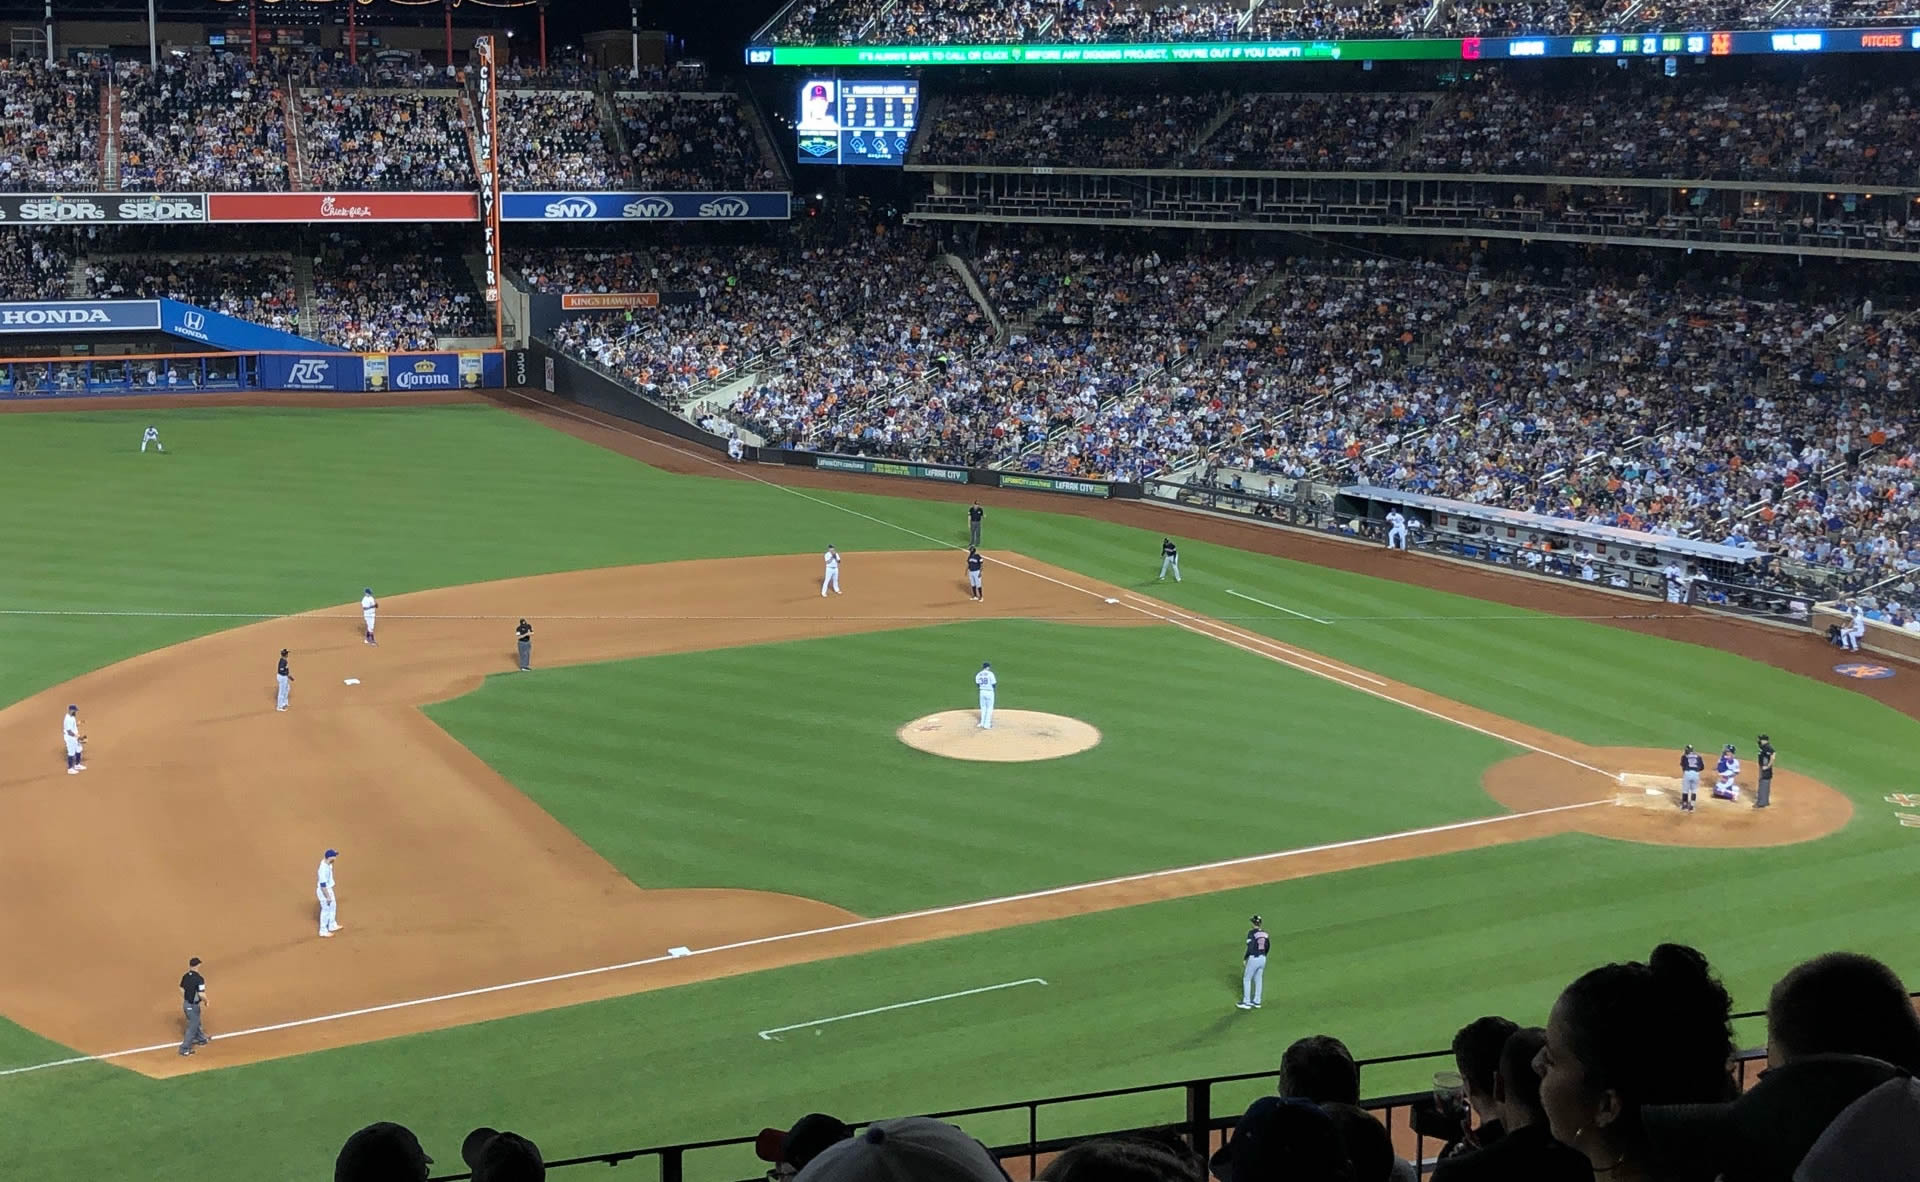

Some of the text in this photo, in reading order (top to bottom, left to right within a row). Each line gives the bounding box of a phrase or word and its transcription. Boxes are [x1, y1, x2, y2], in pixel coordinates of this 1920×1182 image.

[1572, 40, 1592, 53] AVG
[1643, 38, 1656, 53] 21
[1861, 34, 1903, 47] PITCHES
[932, 51, 944, 60] TO
[945, 51, 966, 60] CALL
[1210, 48, 1230, 58] OUT
[1233, 48, 1241, 58] IF
[1244, 48, 1265, 57] YOU
[482, 172, 493, 216] WAY
[544, 203, 588, 218] SNY
[622, 203, 665, 218] SNY
[698, 203, 742, 218] SNY
[485, 227, 495, 285] FAIR
[602, 296, 649, 306] HAWAIIAN
[2, 309, 111, 325] HONDA
[174, 325, 209, 340] HONDA
[288, 359, 330, 384] RTS
[396, 371, 450, 389] Corona
